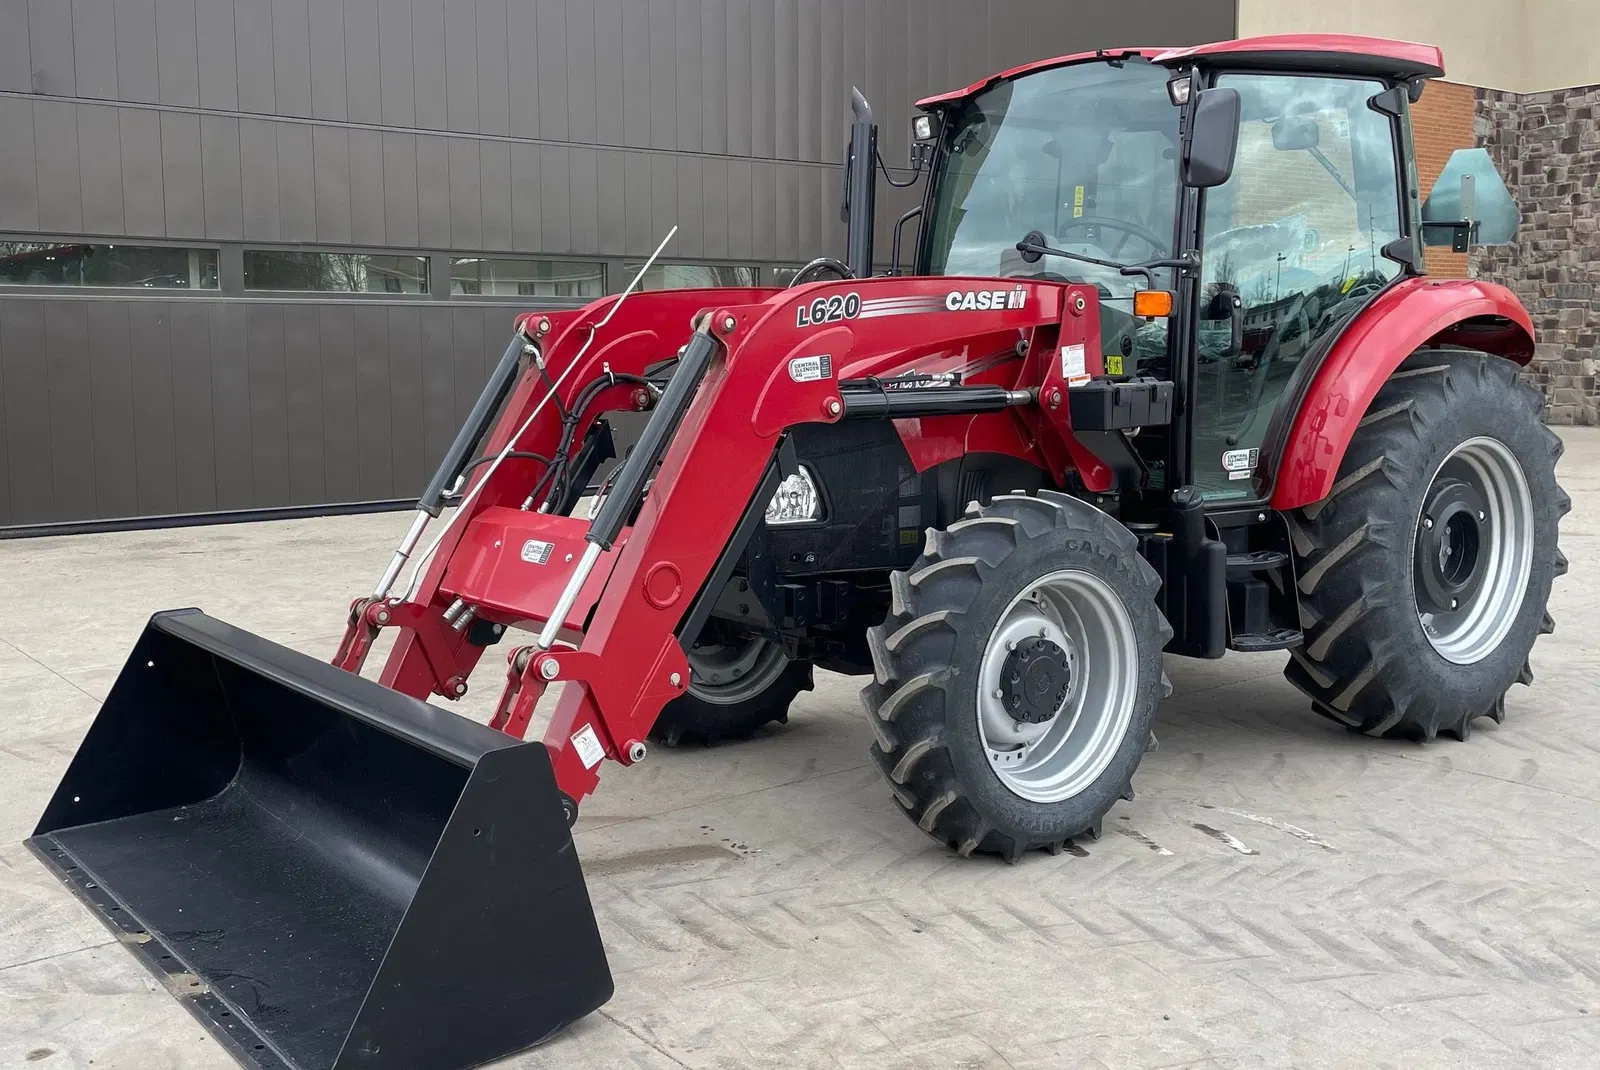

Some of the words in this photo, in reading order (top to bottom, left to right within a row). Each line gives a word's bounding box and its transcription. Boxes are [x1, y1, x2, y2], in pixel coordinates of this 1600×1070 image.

[796, 292, 861, 328] L620
[945, 291, 1006, 311] CASE
[794, 361, 819, 369] CENTRAL
